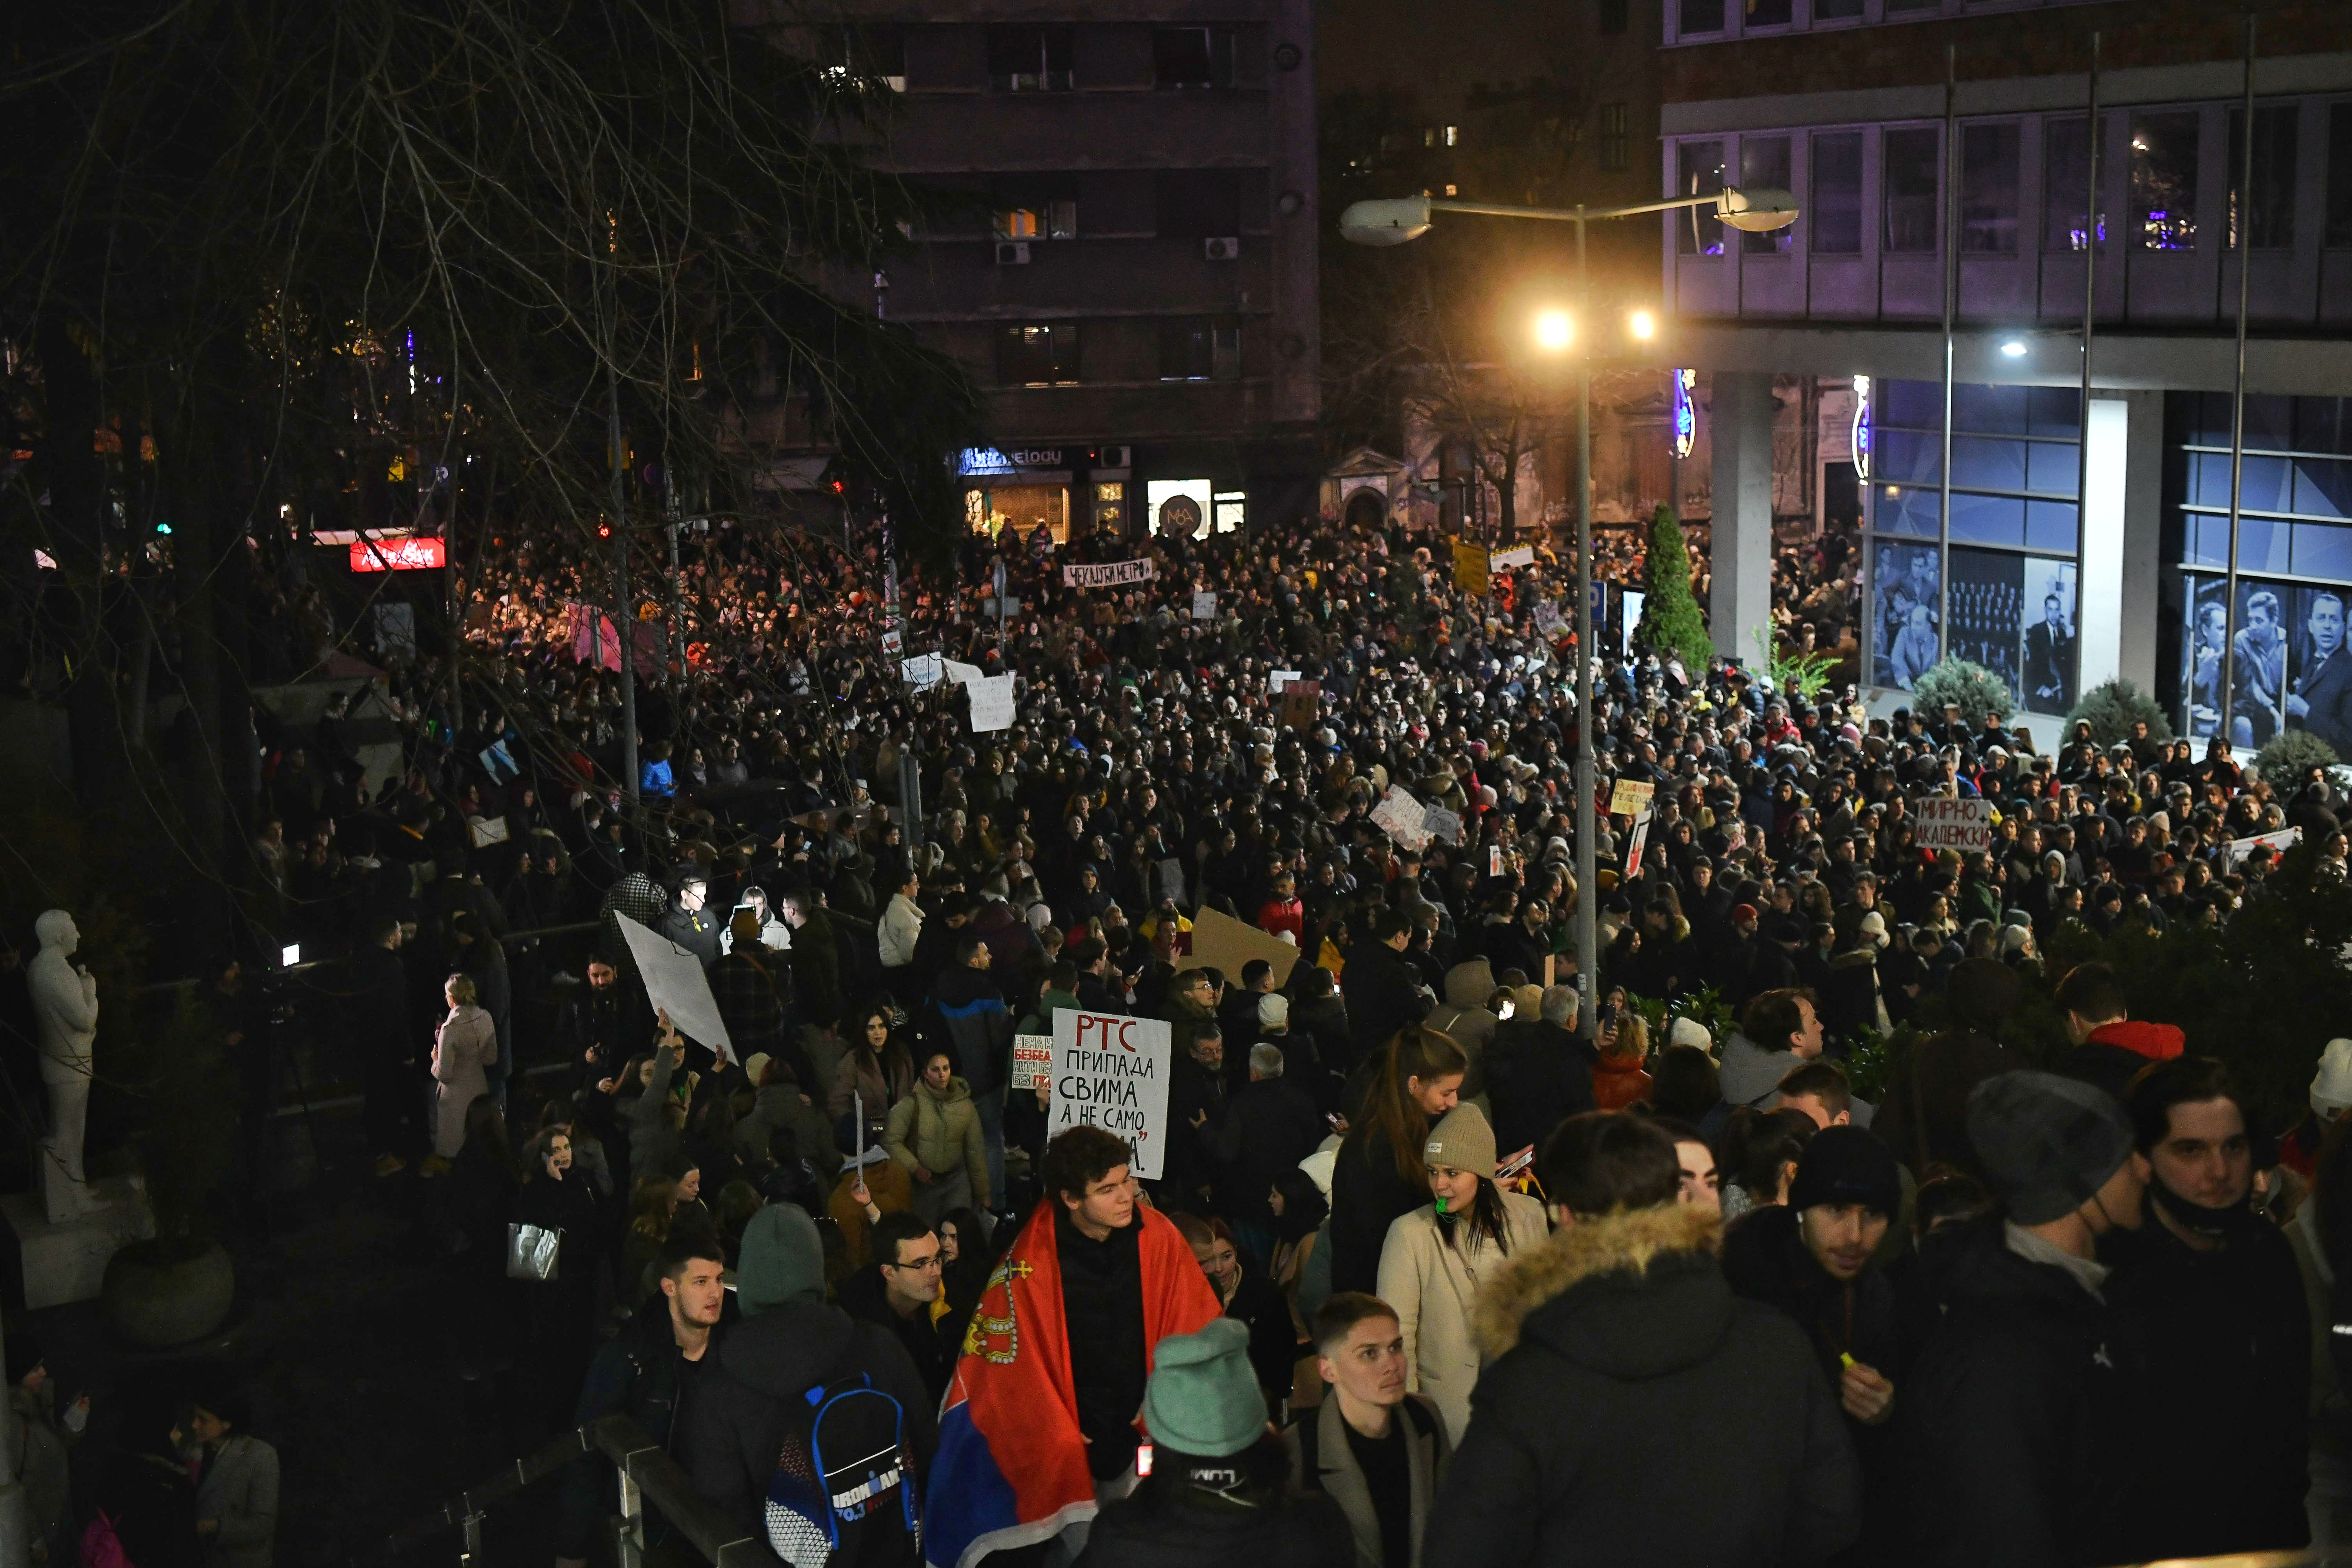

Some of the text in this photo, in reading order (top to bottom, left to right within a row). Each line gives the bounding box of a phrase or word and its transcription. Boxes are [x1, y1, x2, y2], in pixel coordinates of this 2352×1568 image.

[1015, 1036, 1043, 1049] НЕМА
[1076, 1015, 1136, 1053] РТС
[1013, 1061, 1037, 1073] НИТИ
[1067, 1049, 1153, 1079] ПРИПАДА
[1013, 1074, 1030, 1086] БЕЗ
[1059, 1076, 1137, 1107] СВИМА
[1060, 1104, 1144, 1130] А НЕ САМО
